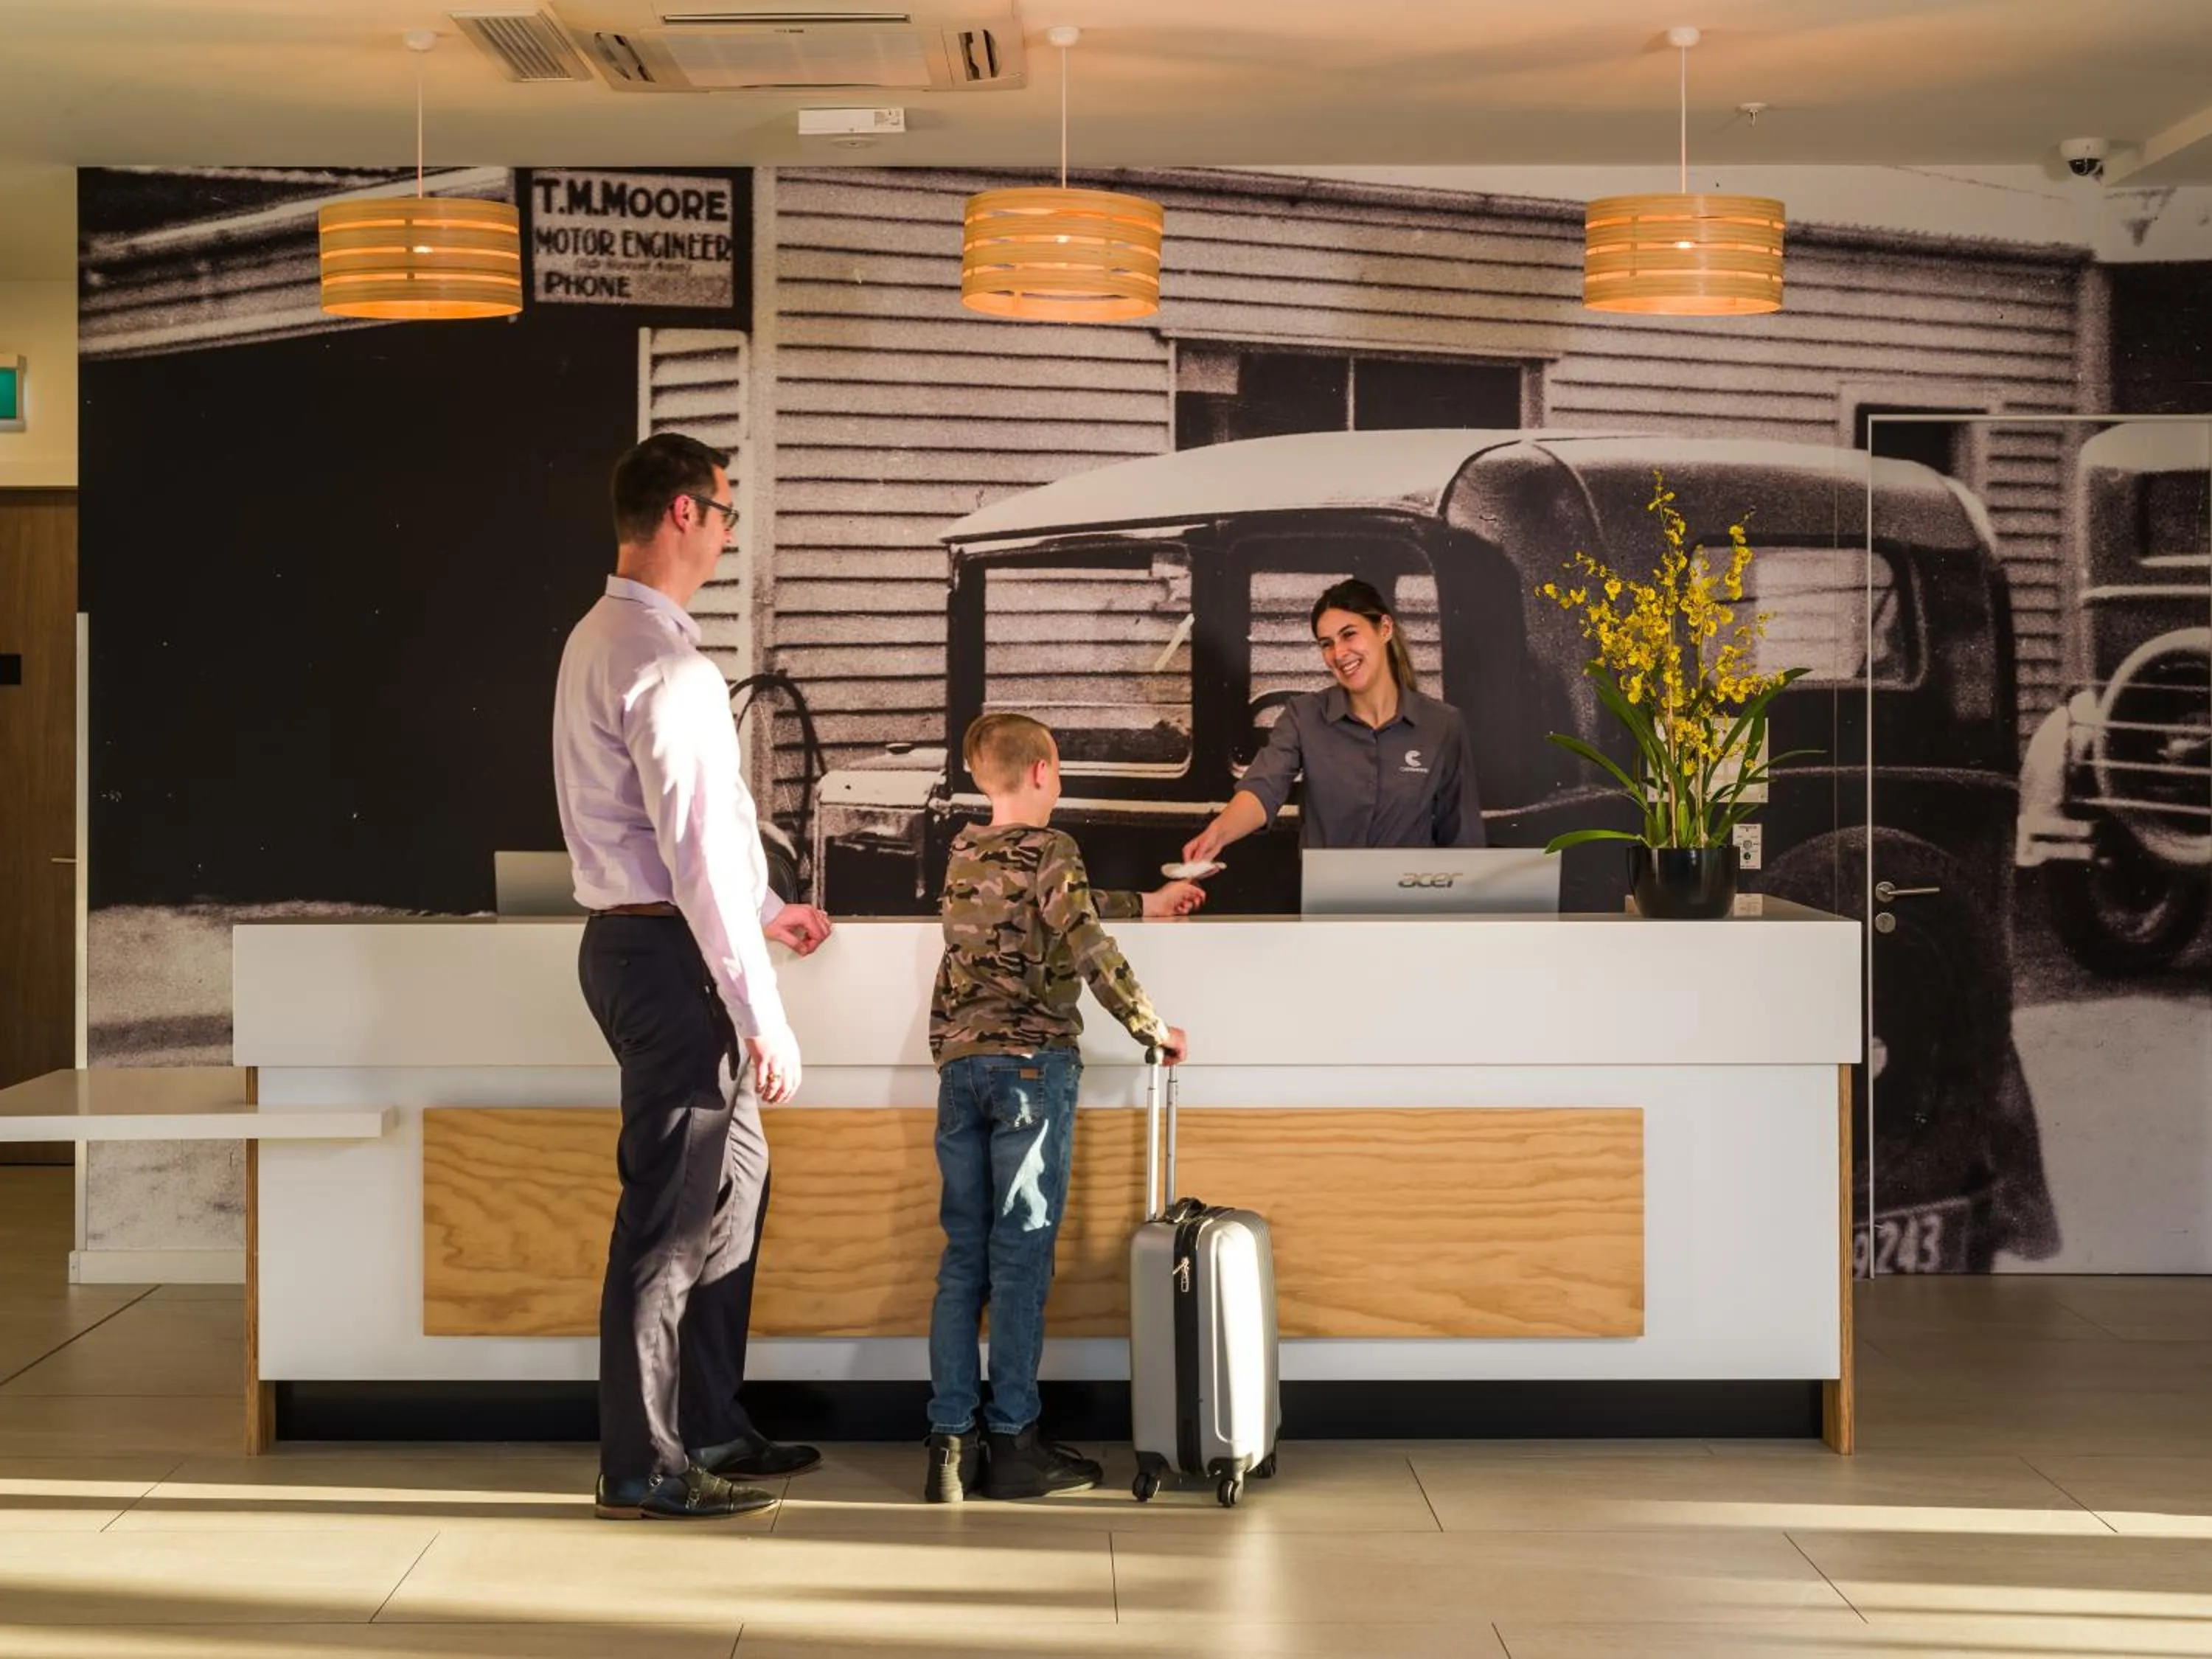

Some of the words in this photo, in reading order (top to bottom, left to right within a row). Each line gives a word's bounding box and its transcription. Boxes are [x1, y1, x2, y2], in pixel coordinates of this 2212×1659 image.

[535, 226, 615, 257] MOTOR
[622, 229, 731, 262] ENGINEER
[544, 271, 632, 298] PHONE
[1398, 872, 1463, 888] acer
